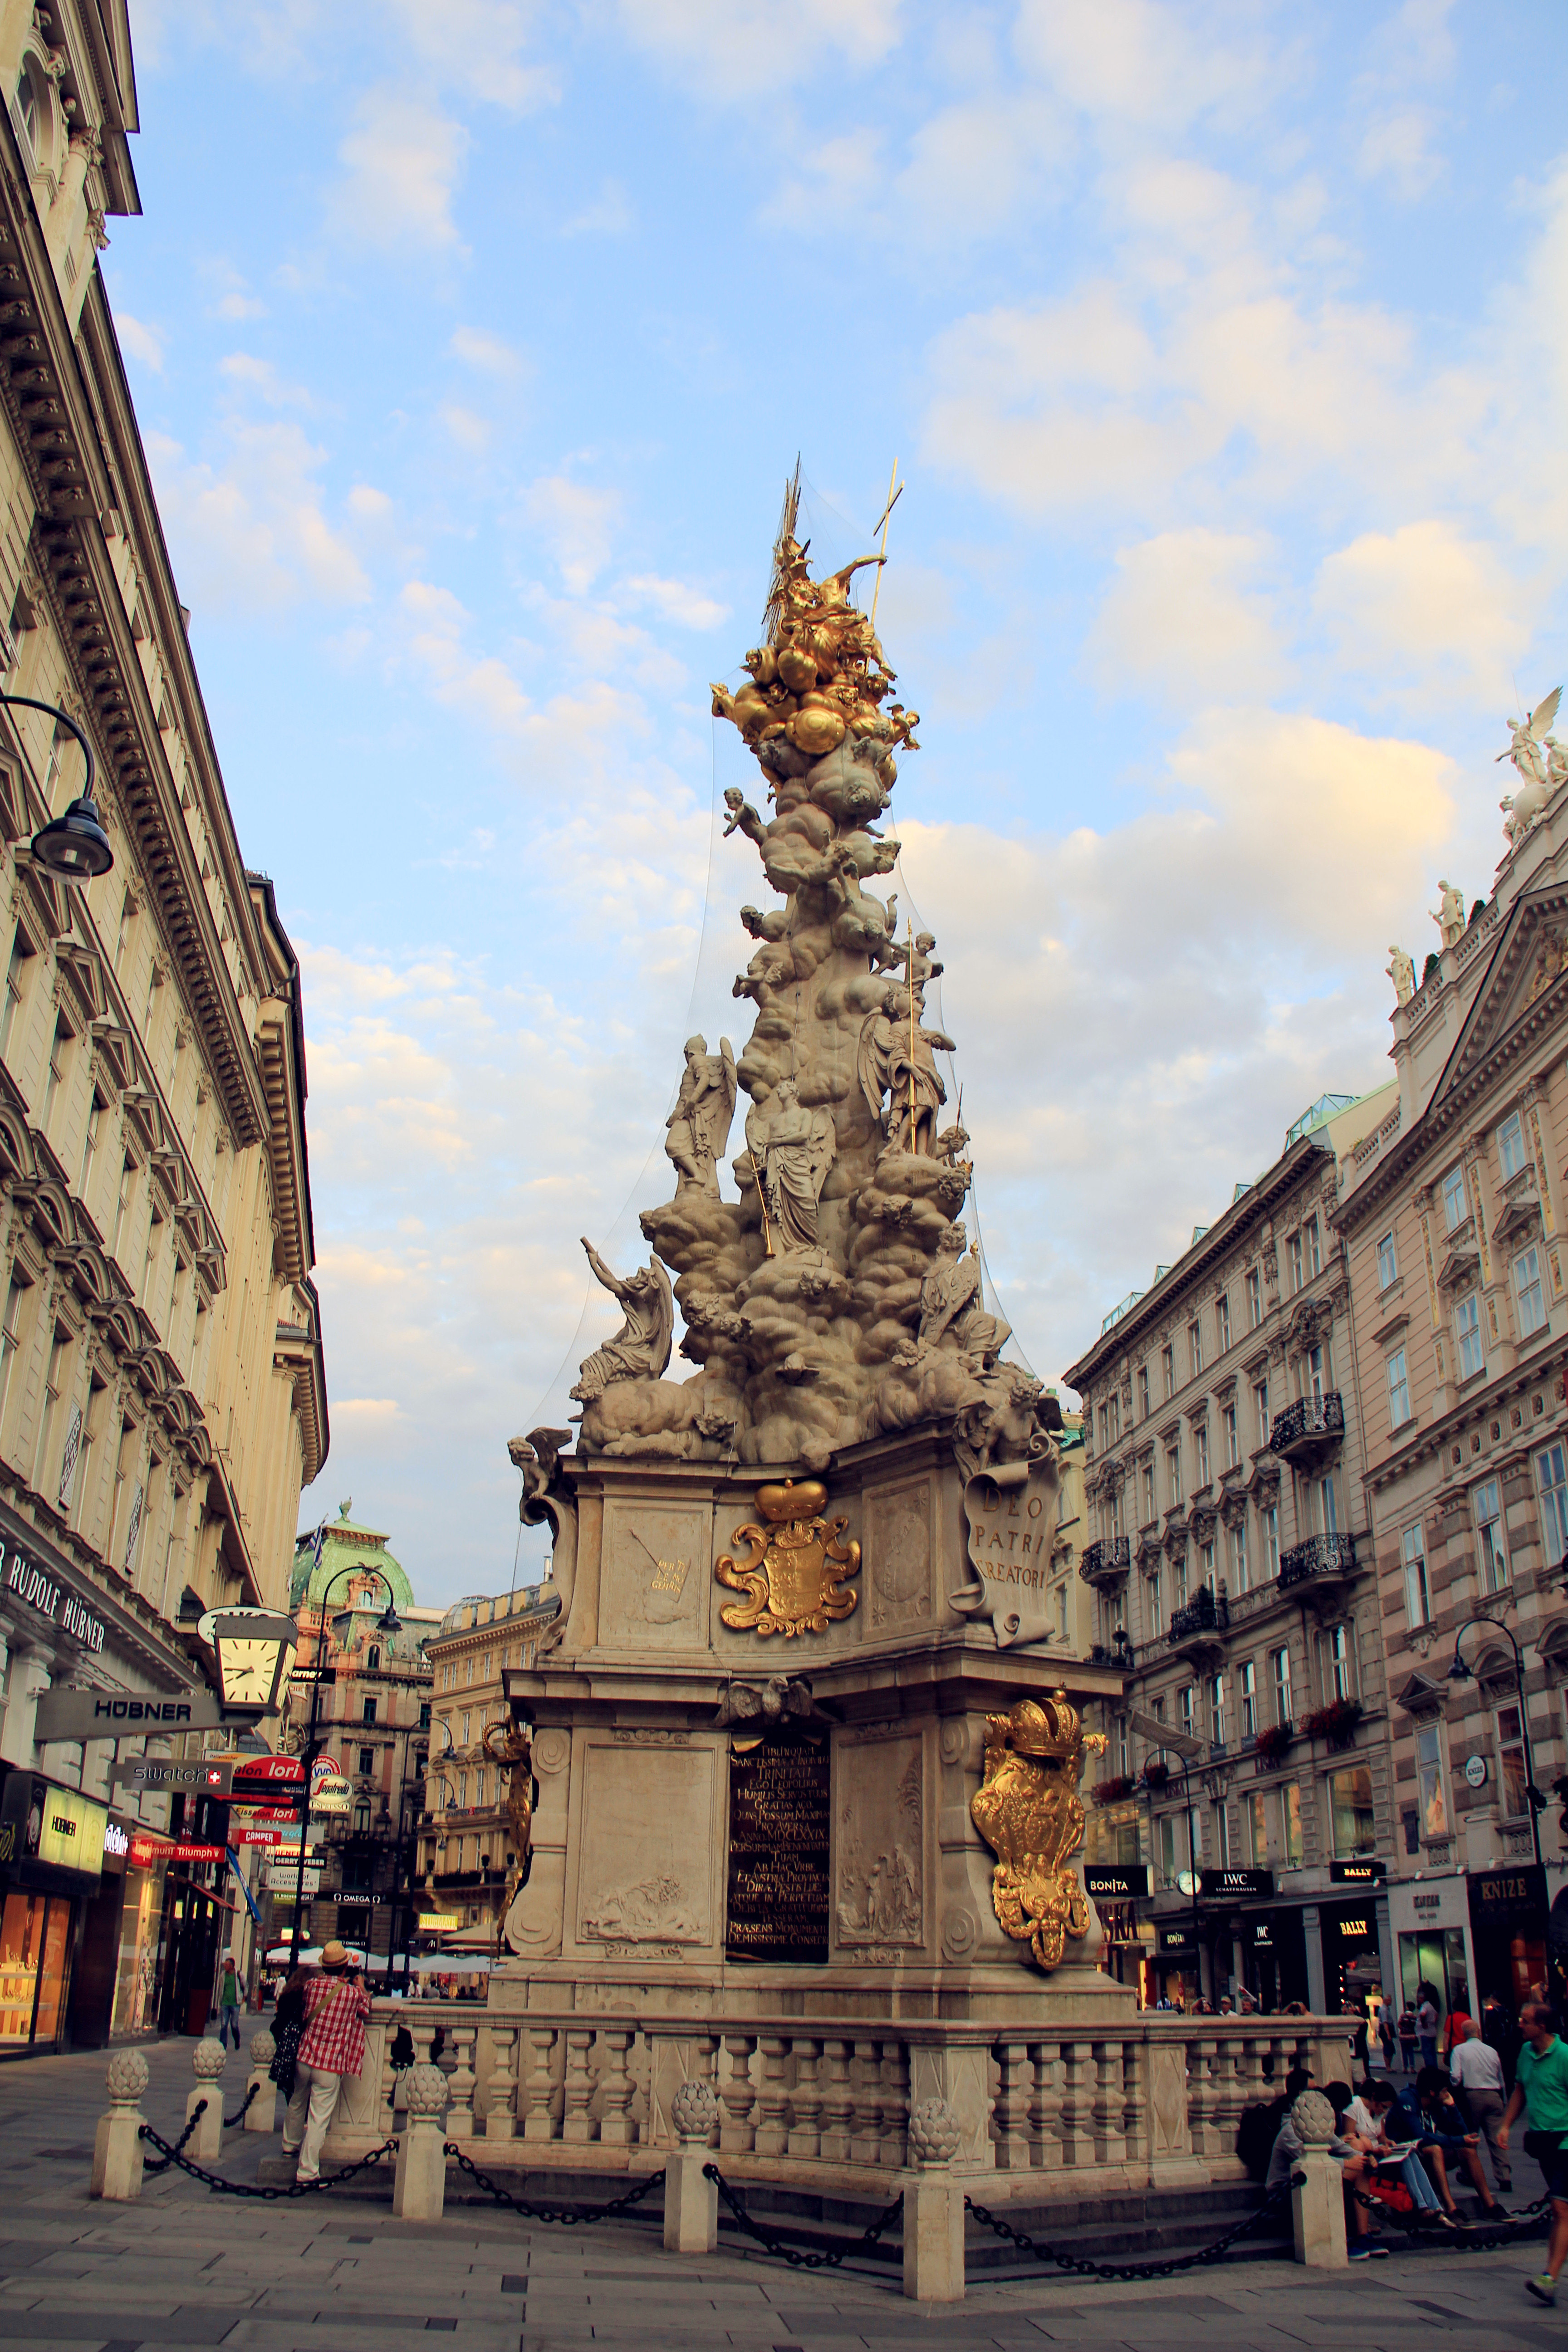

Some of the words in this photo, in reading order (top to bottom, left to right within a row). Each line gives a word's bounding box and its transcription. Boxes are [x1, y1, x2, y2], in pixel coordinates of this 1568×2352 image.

[61, 1446, 78, 1490] PELZE
[983, 1488, 1042, 1518] DEO
[975, 1524, 1044, 1554] PATRI
[975, 1559, 1044, 1588] CREATORI
[9, 1554, 60, 1617] RUDOLF
[63, 1596, 104, 1654] HÜBNER
[95, 1700, 192, 1722] HÜBNER
[134, 1767, 207, 1784] swatch
[313, 1779, 349, 1795] Segafredo
[738, 1788, 774, 1800] HUMILIS
[754, 1799, 793, 1809] GRATIAS
[236, 1806, 270, 1818] Eissalon
[245, 1831, 274, 1843] CAMPER
[177, 1847, 212, 1858] Triumph
[770, 1851, 799, 1862] TUAM
[754, 1861, 769, 1872] AB
[770, 1861, 791, 1872] HAC
[1224, 1873, 1248, 1885] IWC
[1481, 1877, 1527, 1900] KNIZE
[1256, 1926, 1269, 1938] IWC
[1340, 1921, 1367, 1935] BALLY
